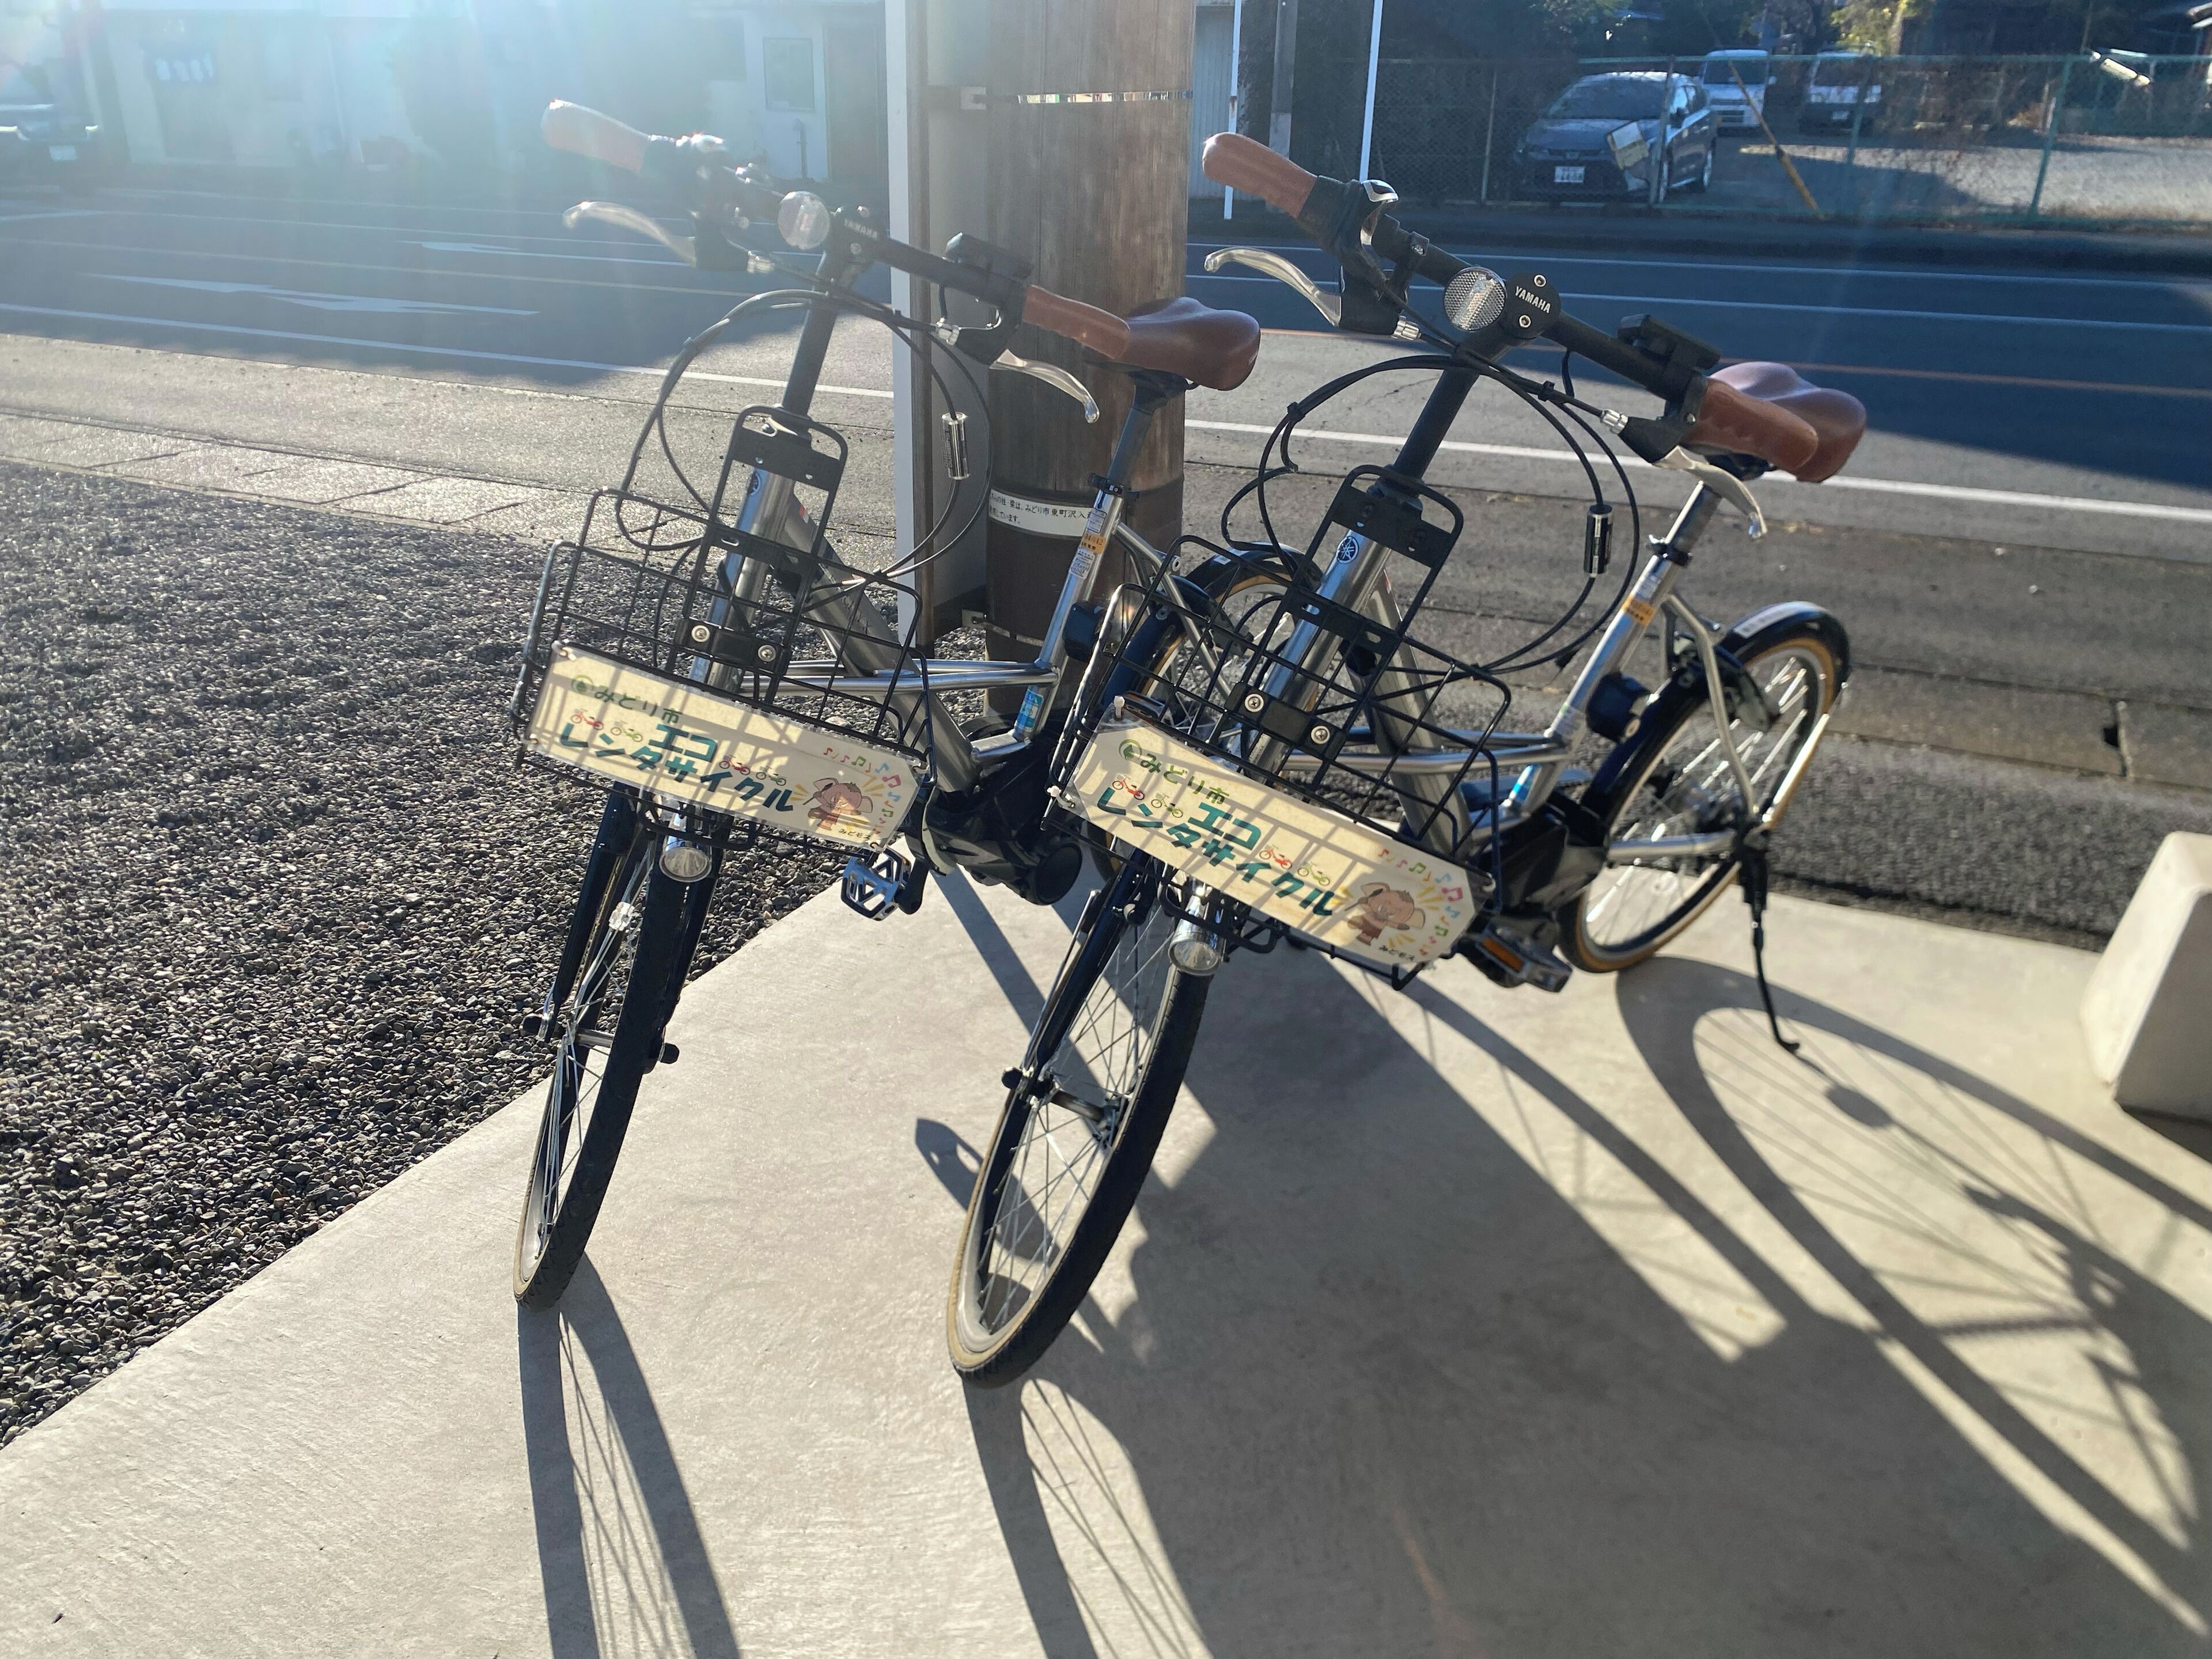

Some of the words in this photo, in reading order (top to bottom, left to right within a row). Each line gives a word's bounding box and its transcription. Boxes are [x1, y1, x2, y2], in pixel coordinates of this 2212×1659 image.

[844, 218, 878, 240] YAMAHA
[1514, 285, 1552, 314] YAMAHA
[593, 684, 683, 725] みどり市
[649, 723, 718, 763] エコ
[559, 724, 795, 812] レンタサイクル
[1139, 752, 1230, 805] みどり市
[838, 828, 871, 841] みどモス
[1188, 801, 1264, 851] エコ
[1097, 786, 1336, 916] レンタサイクル
